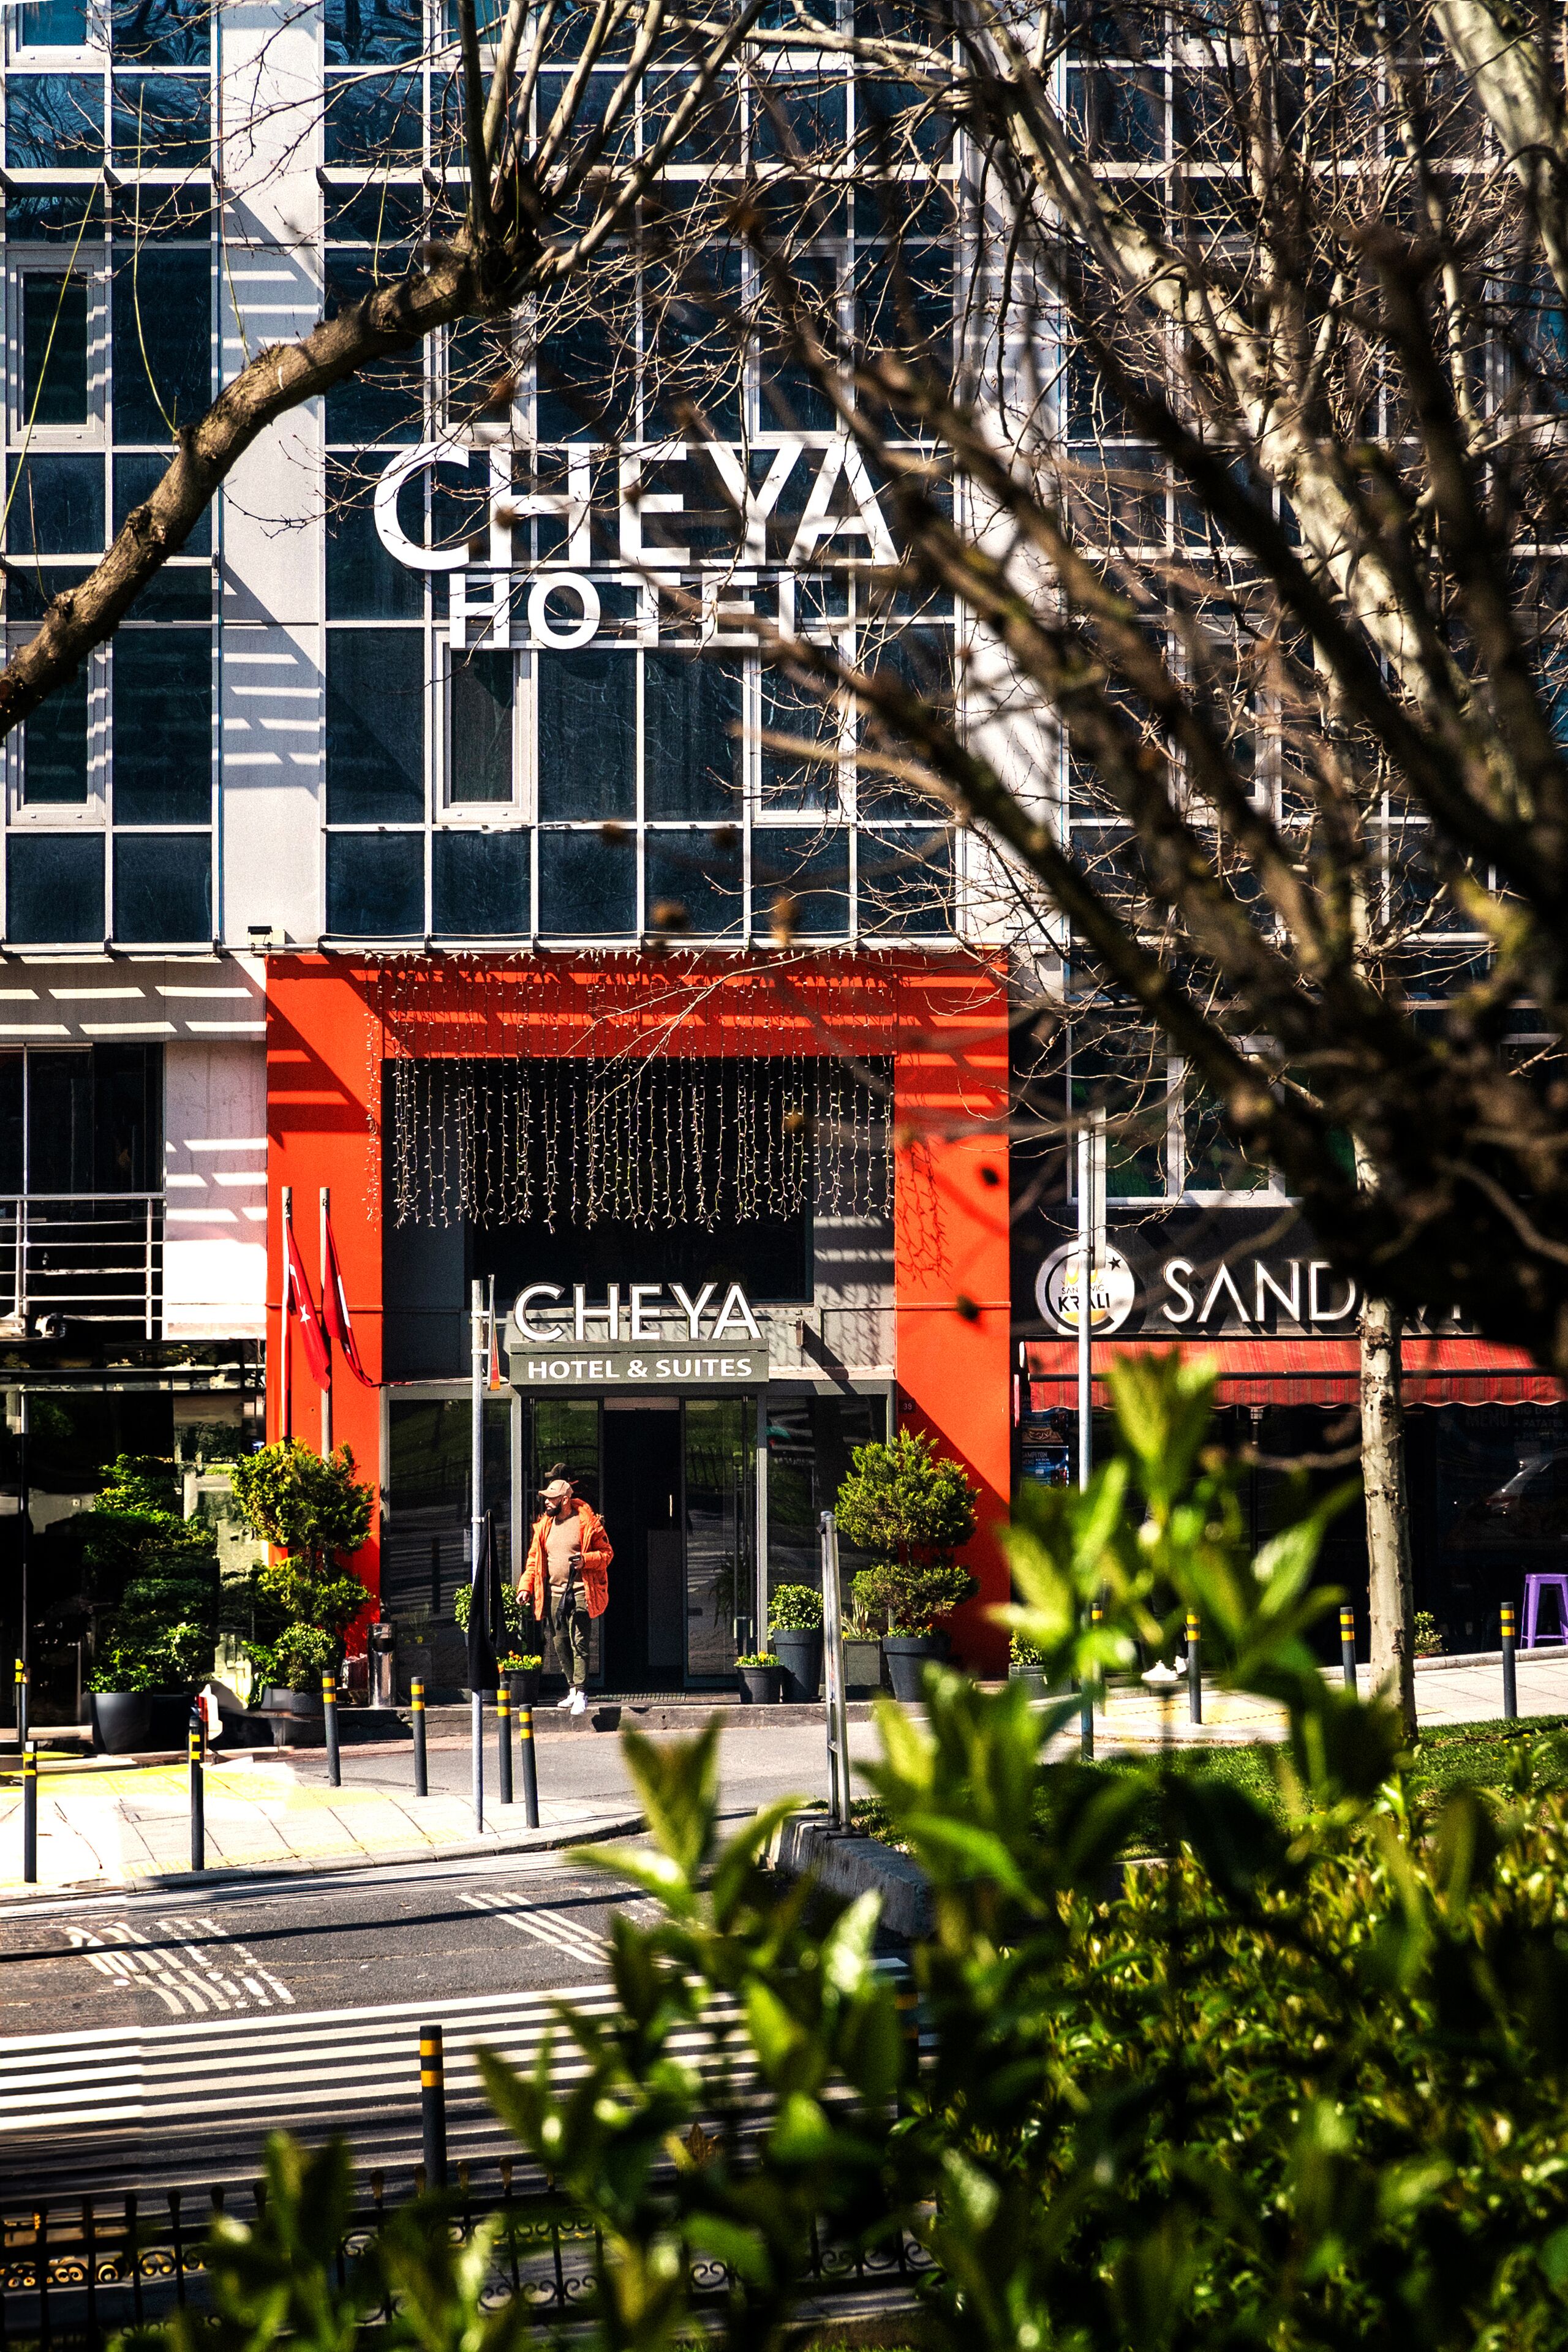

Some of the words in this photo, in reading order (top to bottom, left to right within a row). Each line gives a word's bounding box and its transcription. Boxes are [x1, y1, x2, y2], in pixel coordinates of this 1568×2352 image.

[374, 441, 900, 570] CHEYA
[450, 571, 834, 649] HOTEL
[513, 1282, 763, 1342] CHEYA
[527, 1359, 620, 1379] HOTEL
[627, 1359, 648, 1378] &
[655, 1357, 753, 1378] SUITES
